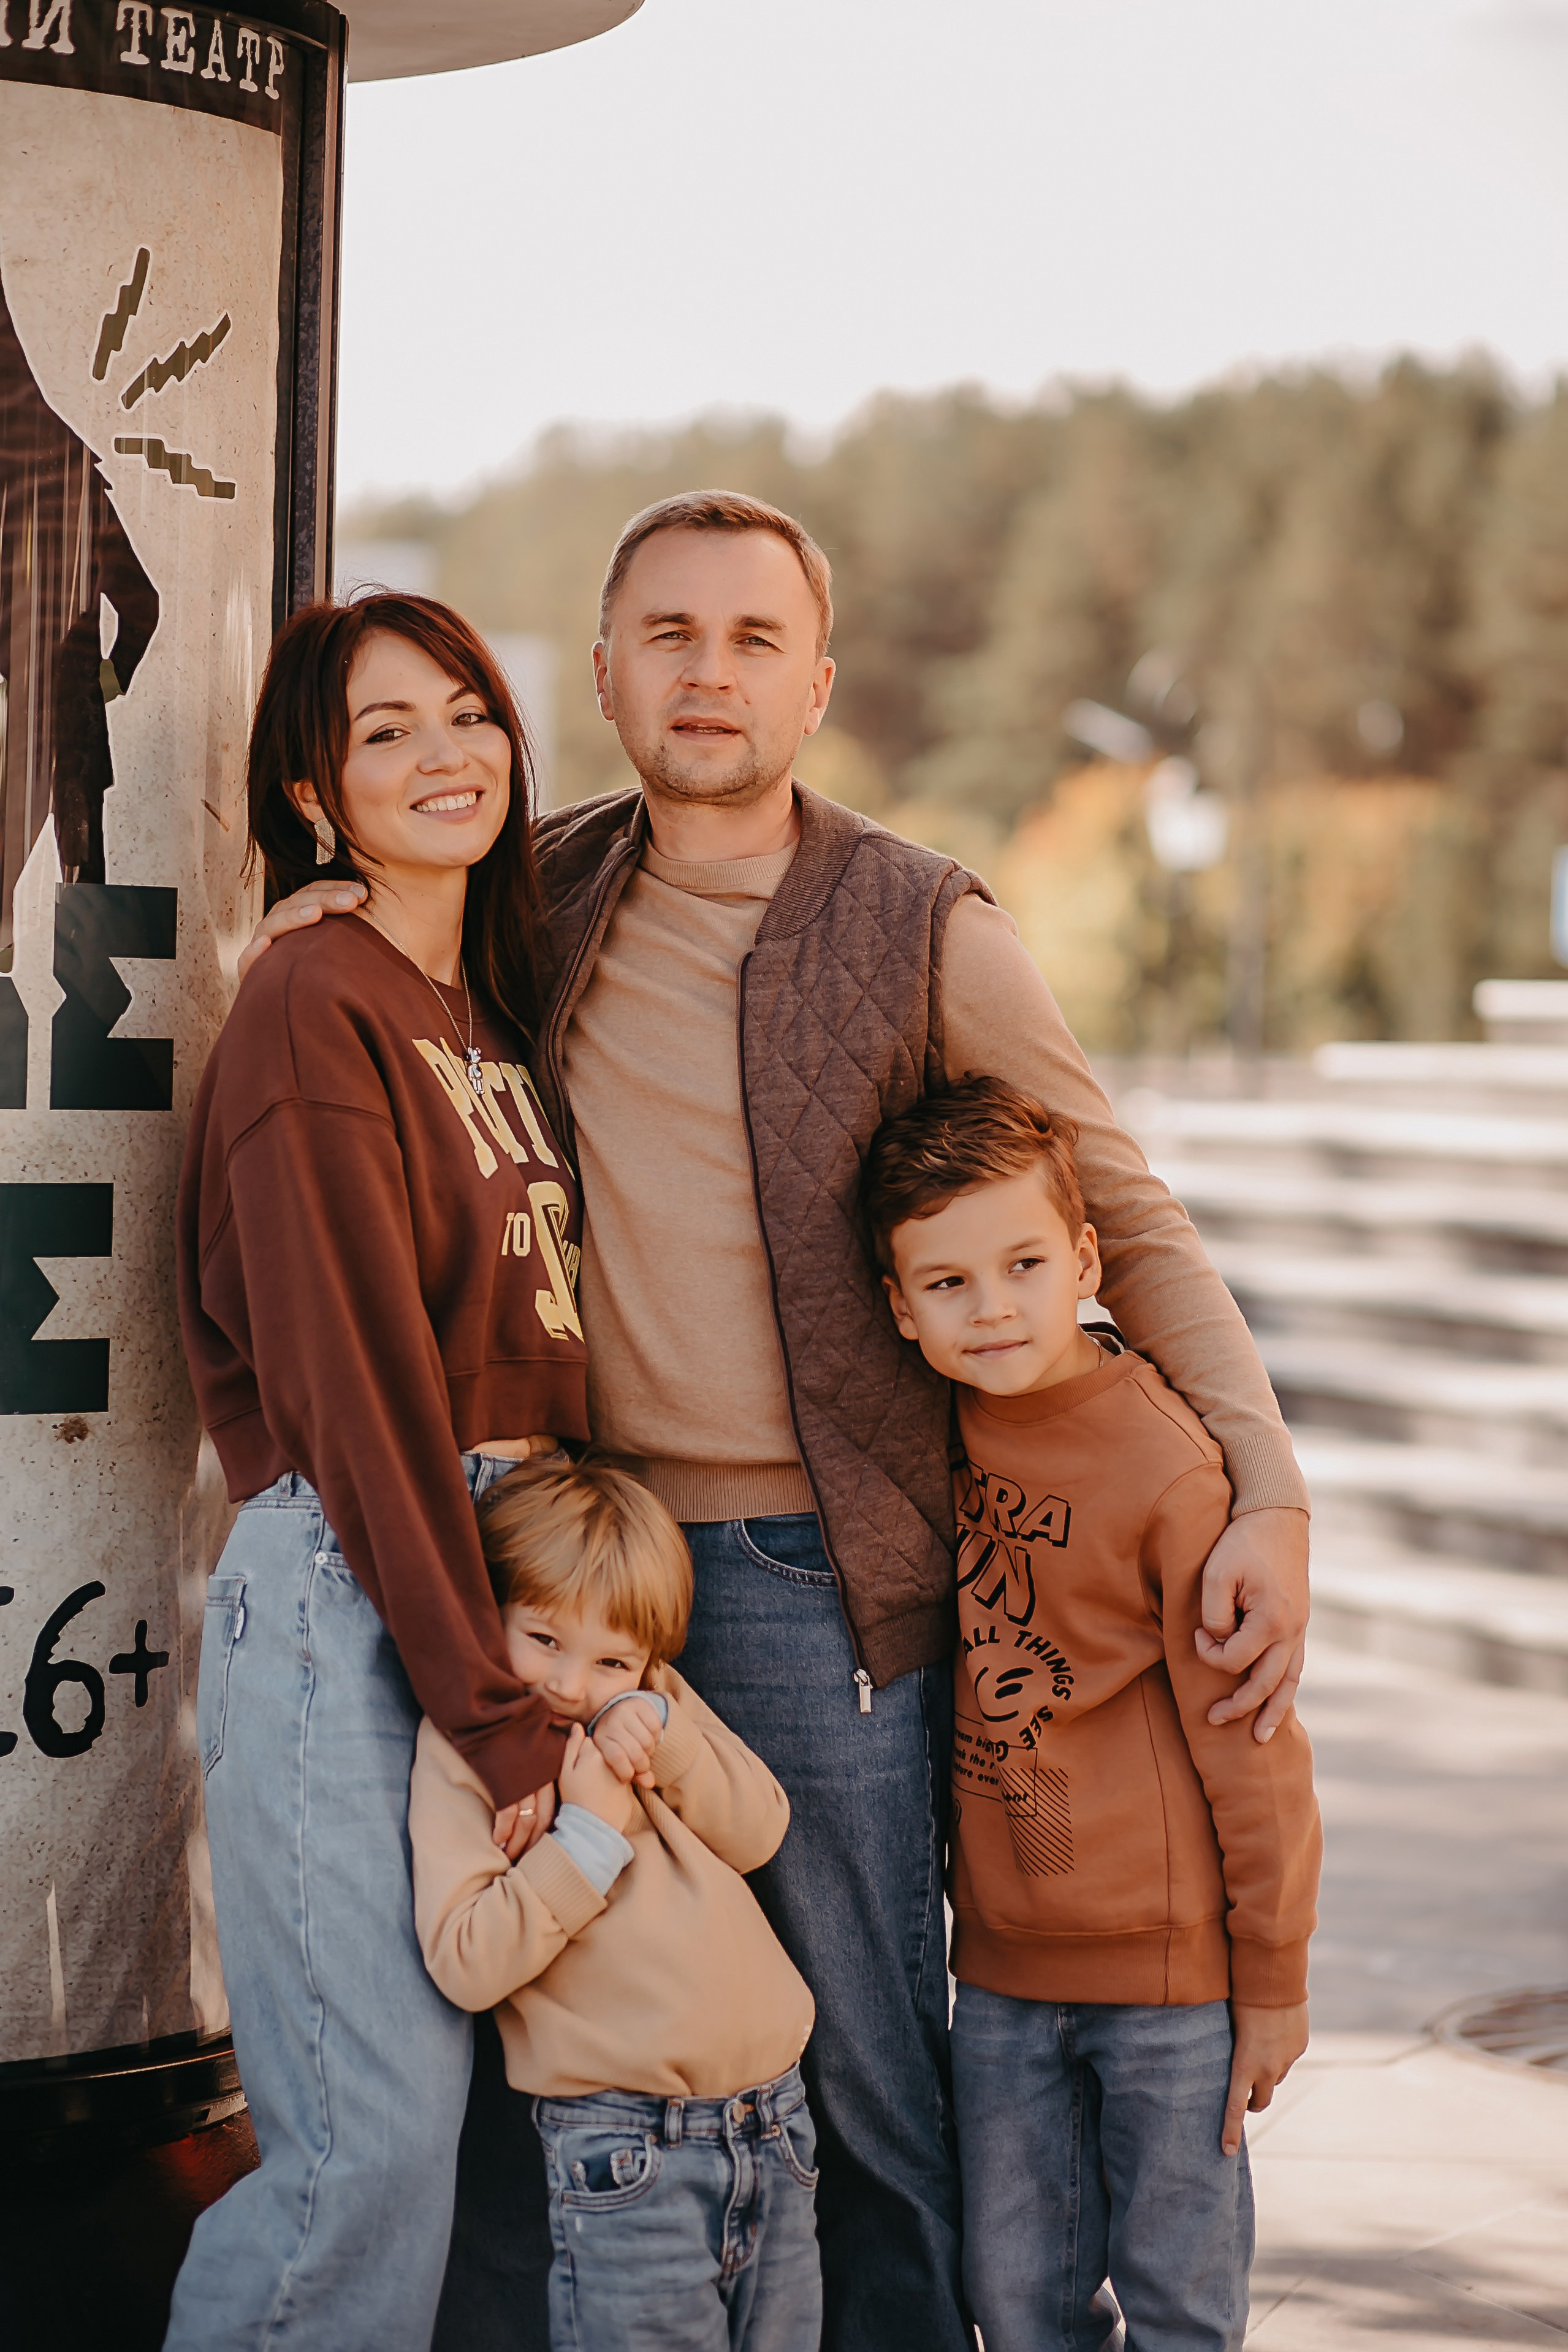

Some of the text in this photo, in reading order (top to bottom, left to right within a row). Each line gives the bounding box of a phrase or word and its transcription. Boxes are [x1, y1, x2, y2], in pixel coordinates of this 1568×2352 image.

[116, 0, 284, 100] ТЕАТР
[963, 1626, 1000, 1657] ALL
[1013, 1630, 1075, 1701] THINGS
[1019, 1705, 1054, 1750] SEE
